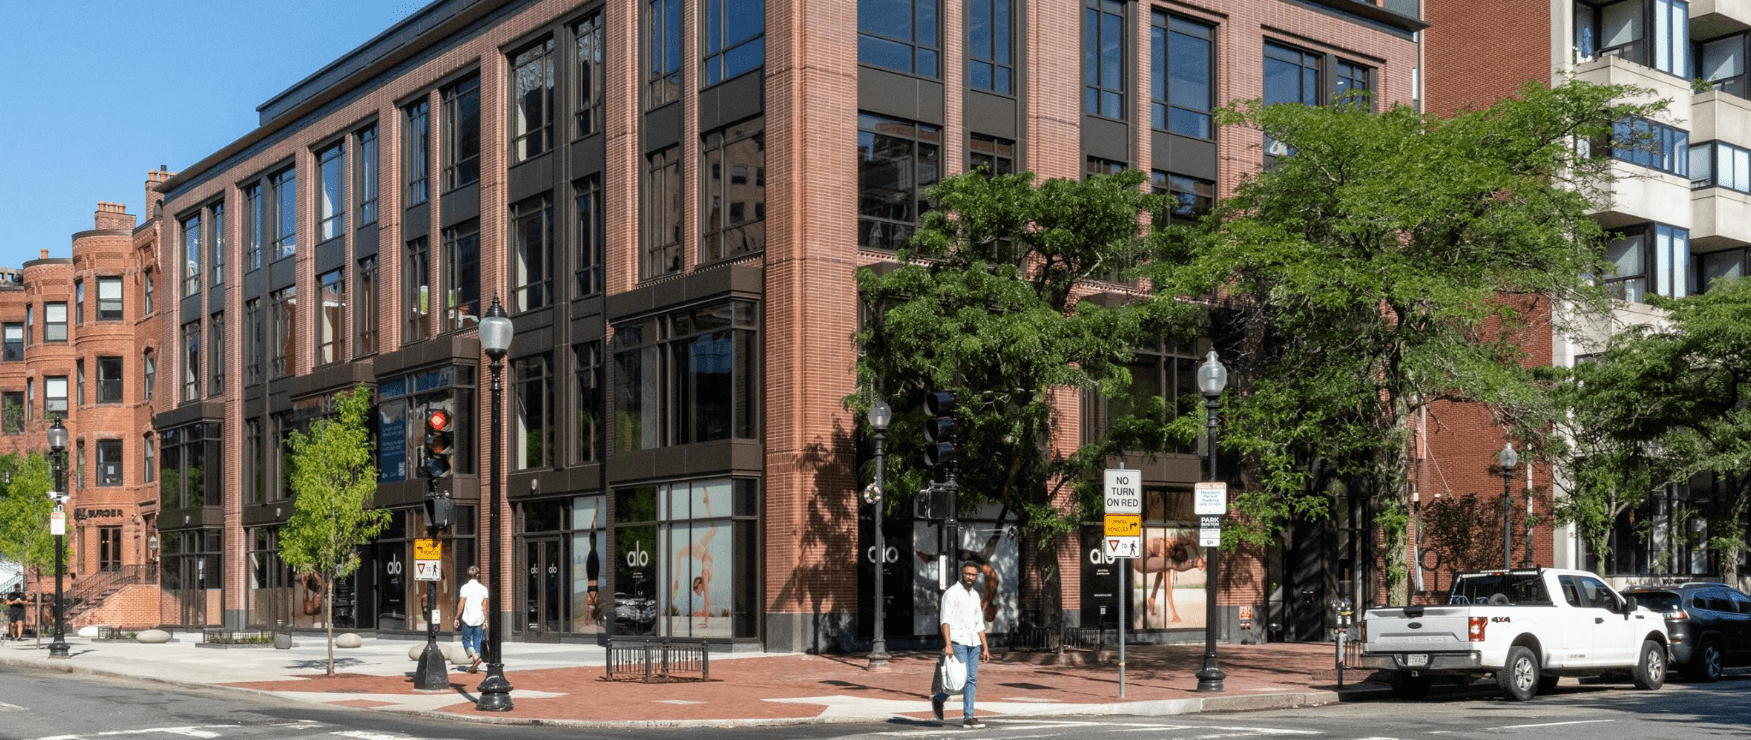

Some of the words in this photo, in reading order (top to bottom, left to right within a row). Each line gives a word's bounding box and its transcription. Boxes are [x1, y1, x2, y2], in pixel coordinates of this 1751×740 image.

[1116, 476, 1129, 485] NO
[1111, 487, 1134, 496] TURN
[1106, 498, 1119, 506] ON
[1121, 498, 1138, 507] RED
[88, 509, 123, 518] BURGER
[627, 540, 648, 567] alo
[1090, 539, 1115, 564] alo
[387, 553, 401, 574] alo
[548, 562, 557, 573] alo
